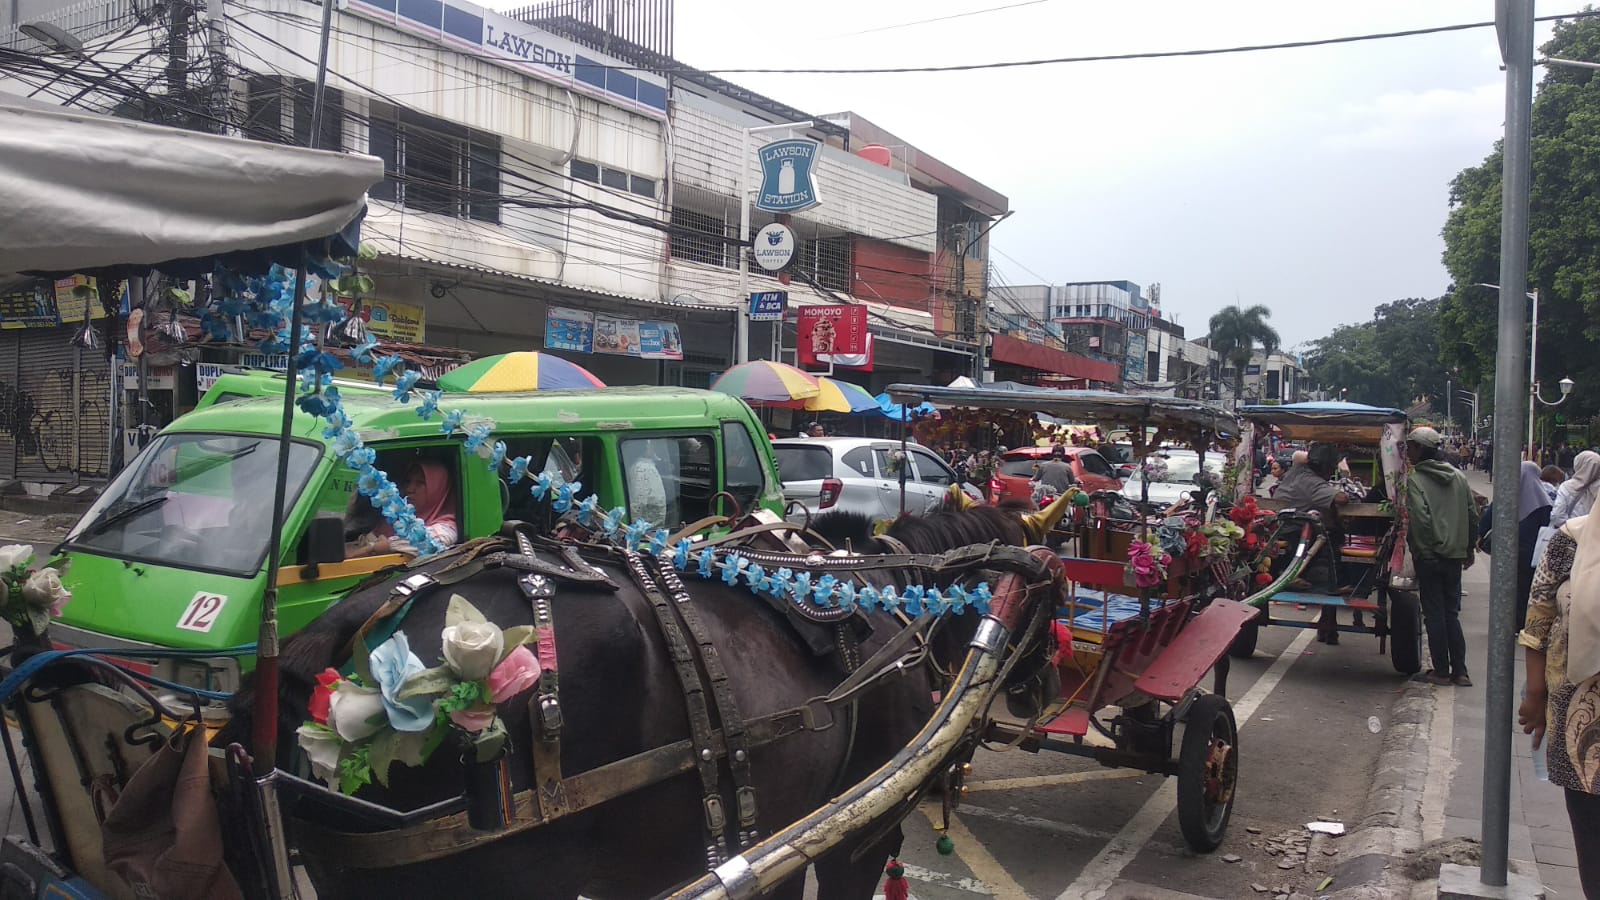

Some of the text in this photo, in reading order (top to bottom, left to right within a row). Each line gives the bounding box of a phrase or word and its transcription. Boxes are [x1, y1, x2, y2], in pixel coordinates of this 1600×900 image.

[487, 25, 571, 74] LAWSON
[765, 146, 810, 161] LAWSON
[764, 190, 808, 205] STATION
[757, 249, 790, 257] LAWSON
[761, 293, 778, 301] ATM
[766, 302, 781, 310] BCA
[804, 308, 842, 316] MOMOYO
[244, 354, 288, 368] DUPLIKA
[183, 595, 221, 628] 12
